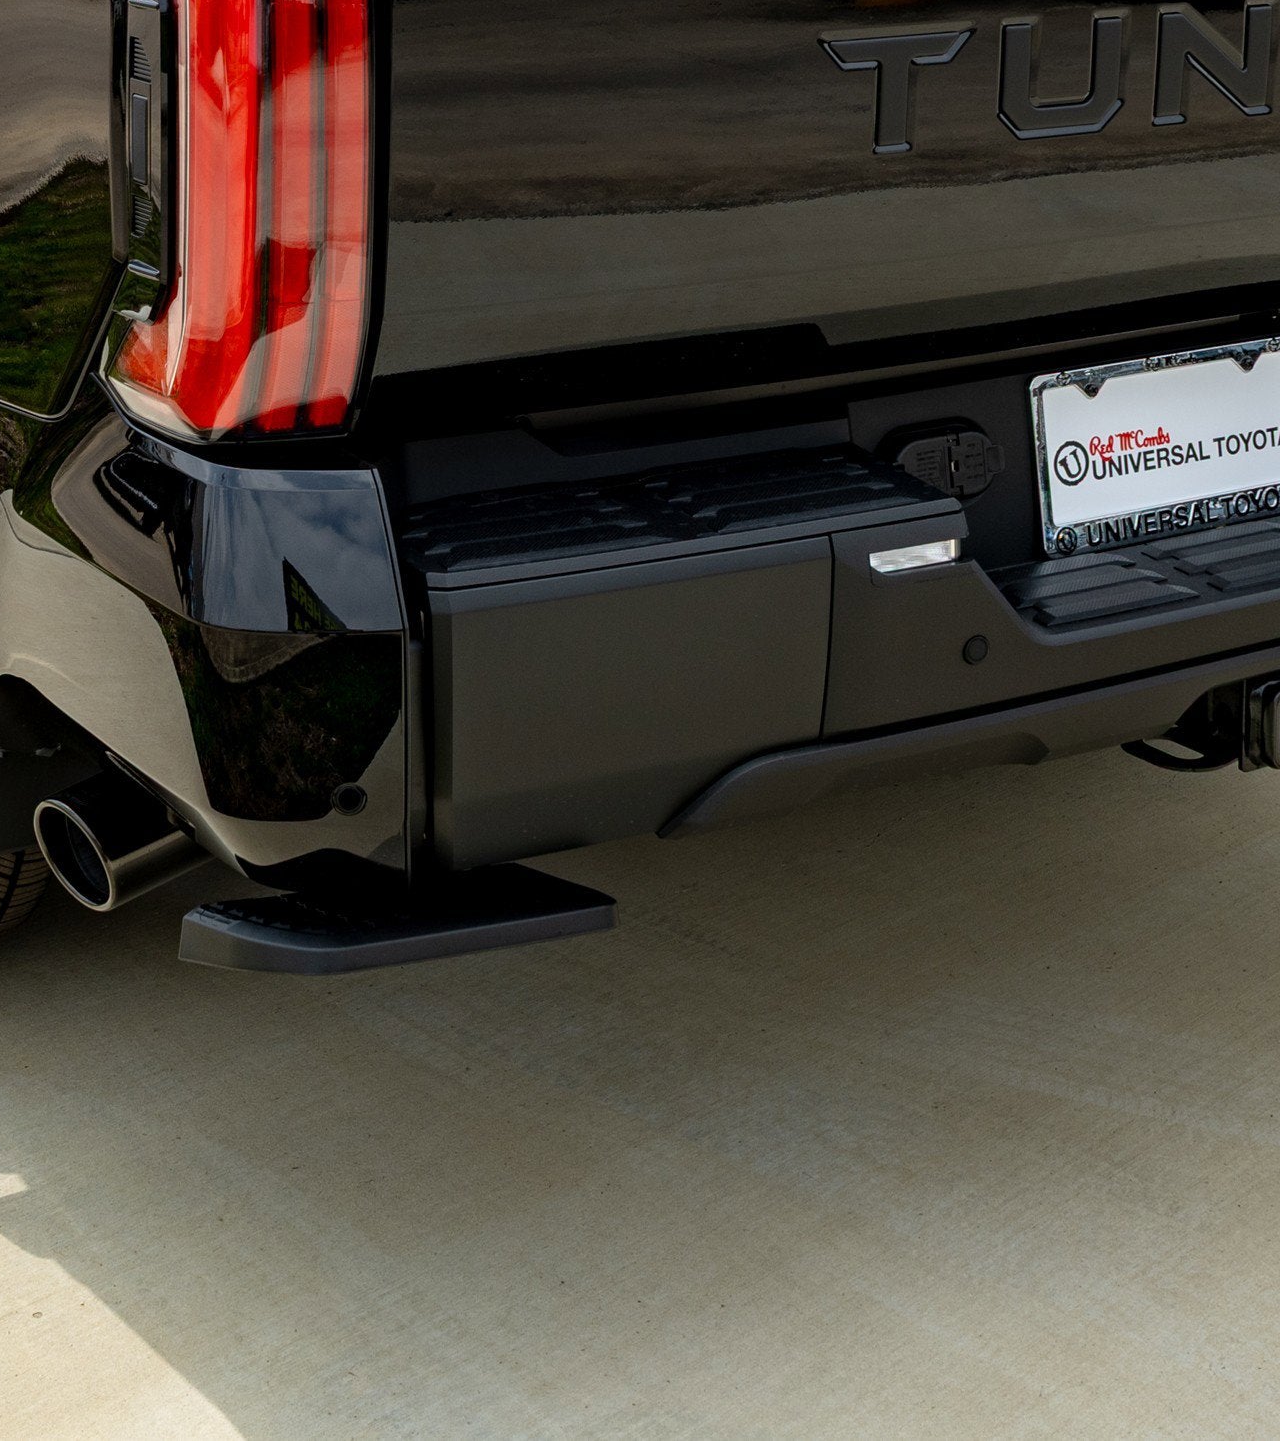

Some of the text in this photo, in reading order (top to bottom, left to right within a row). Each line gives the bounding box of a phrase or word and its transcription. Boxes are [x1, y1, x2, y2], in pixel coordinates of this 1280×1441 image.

[1089, 435, 1115, 462] Red
[1091, 440, 1210, 480] UNIVERSAL
[1085, 500, 1219, 547] UNIVERSAL
